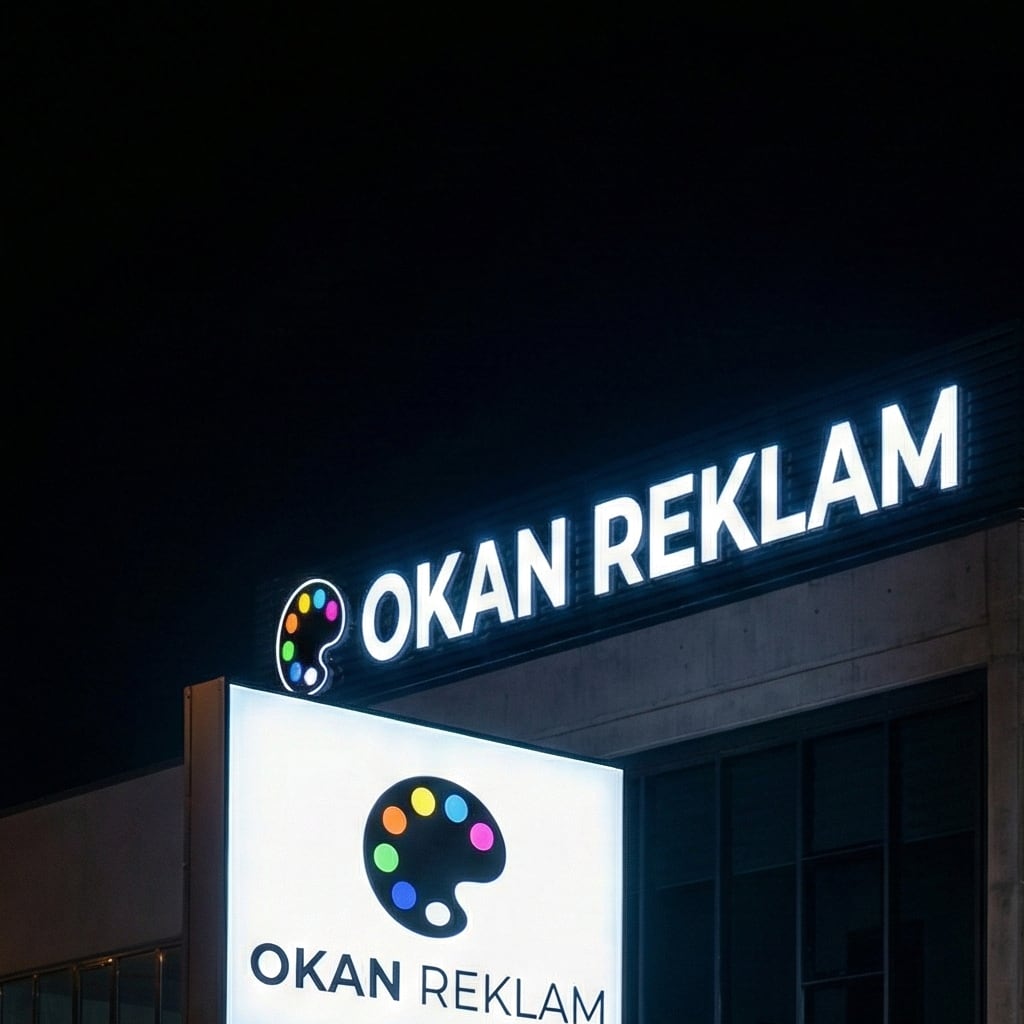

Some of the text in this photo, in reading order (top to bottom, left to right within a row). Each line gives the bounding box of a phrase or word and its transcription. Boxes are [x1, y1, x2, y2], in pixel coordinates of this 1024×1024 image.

[360, 384, 960, 663] OKAN REKLAM
[250, 942, 401, 1003] OKAN
